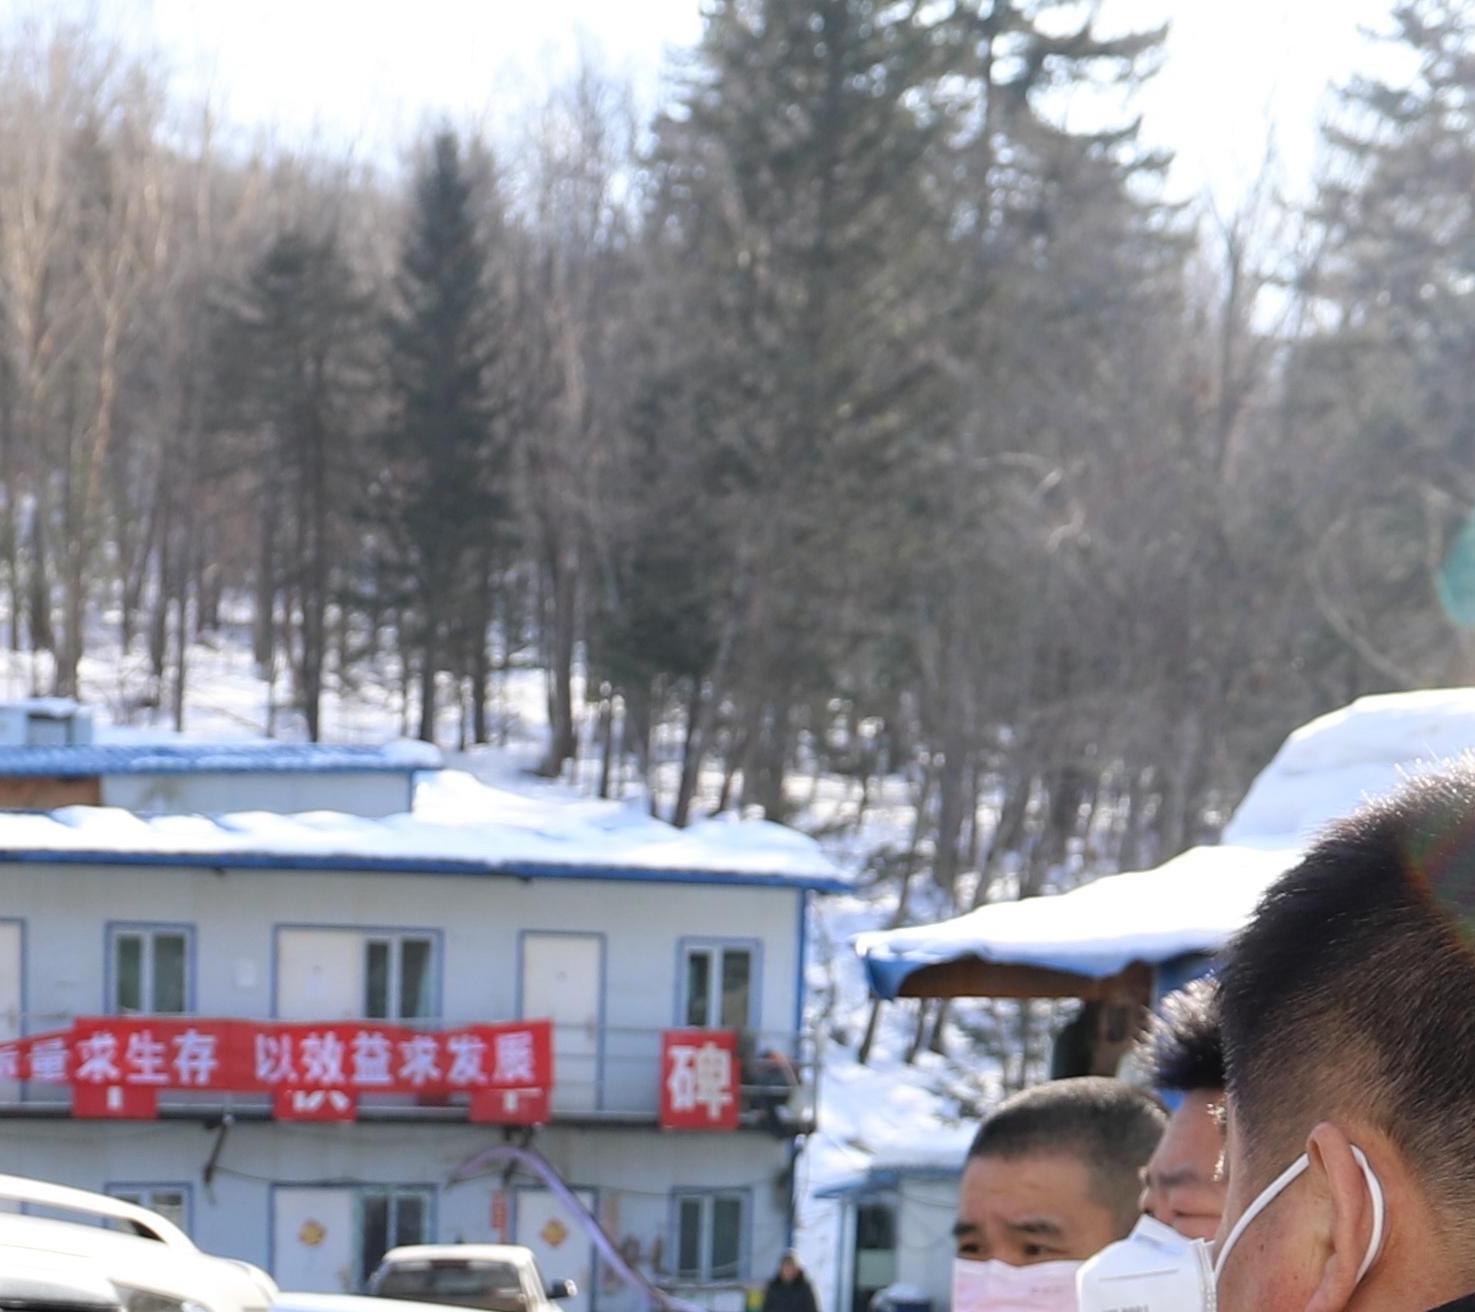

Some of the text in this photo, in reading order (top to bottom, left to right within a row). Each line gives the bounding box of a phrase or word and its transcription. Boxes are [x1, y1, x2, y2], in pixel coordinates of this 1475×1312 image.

[254, 1030, 535, 1086] 以效益求发展
[668, 1041, 733, 1118] 碑
